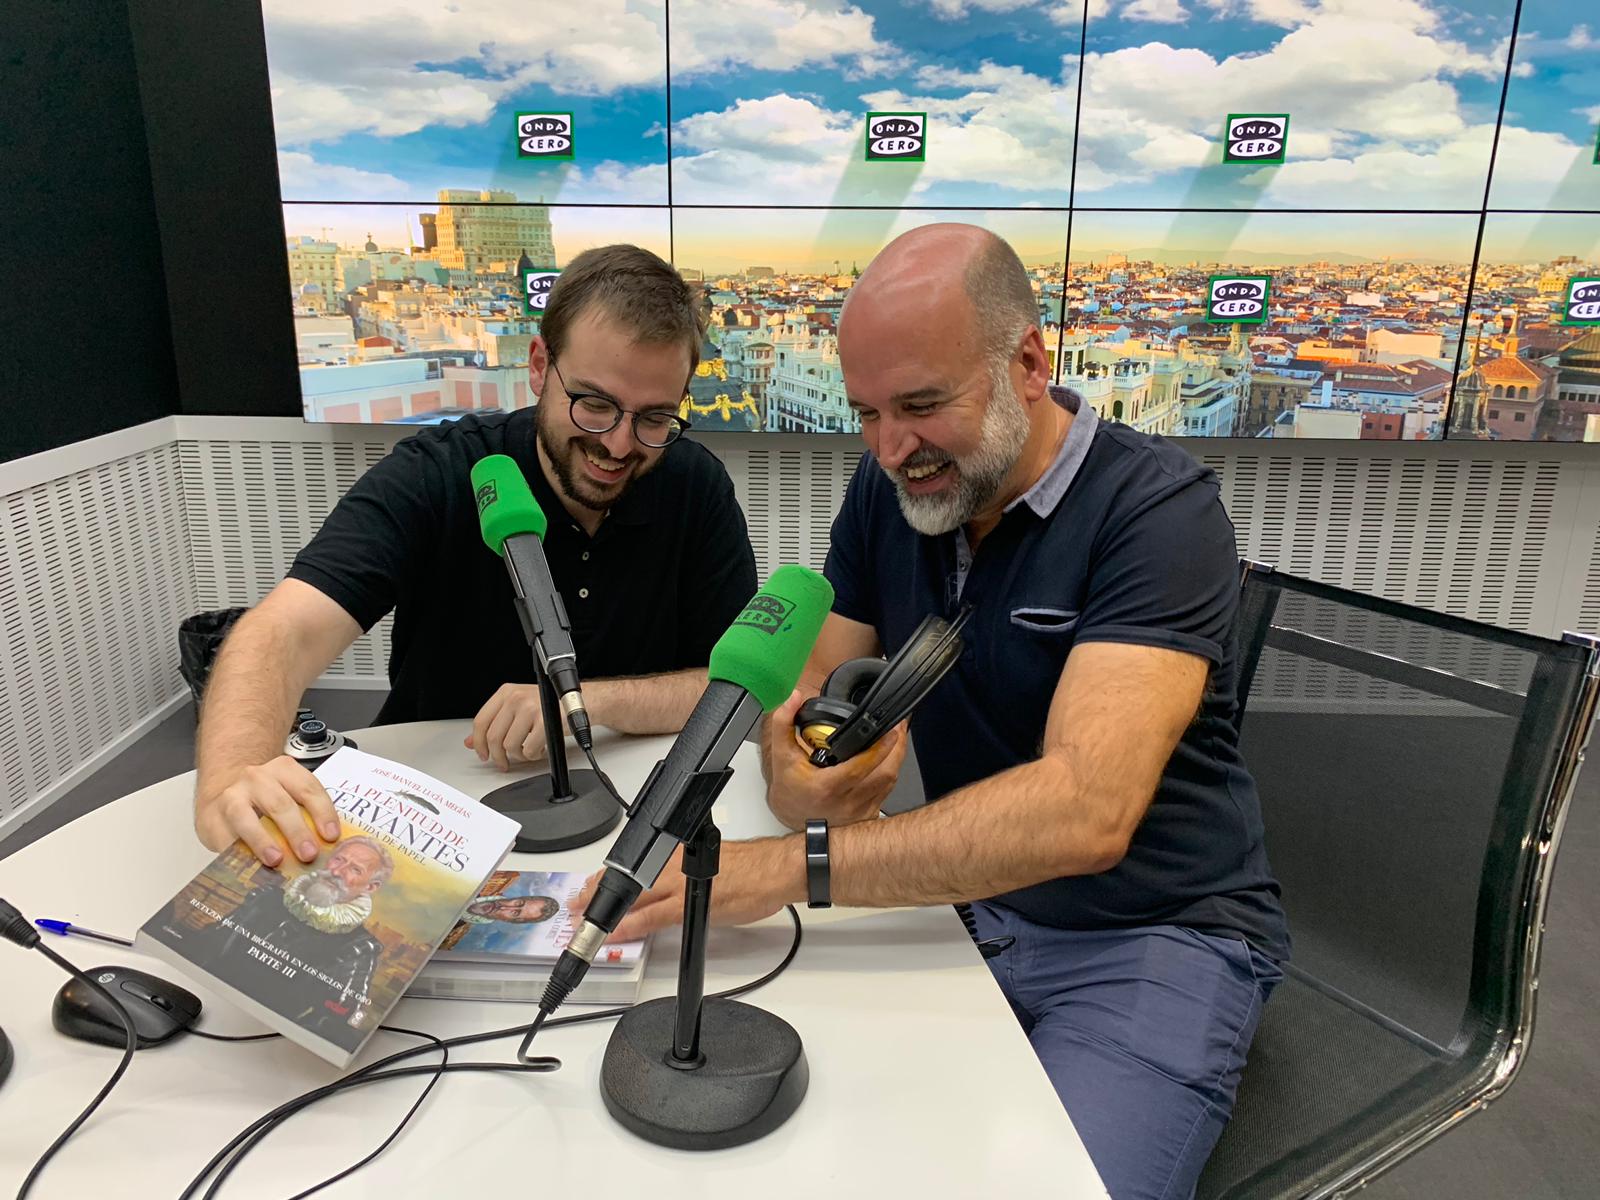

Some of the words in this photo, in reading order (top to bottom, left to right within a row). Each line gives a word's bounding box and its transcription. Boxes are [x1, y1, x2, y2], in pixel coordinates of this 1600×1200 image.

[525, 123, 564, 132] ONDA
[876, 124, 915, 134] ONDA
[1236, 126, 1276, 136] ONDA
[528, 139, 564, 149] CERO
[878, 140, 915, 150] CERO
[1237, 142, 1275, 153] CERO
[533, 280, 552, 289] ON
[1218, 287, 1257, 297] ONDA
[1577, 289, 1600, 298] ON
[1219, 303, 1256, 312] CERO
[751, 600, 780, 612] NDA
[391, 773, 421, 791] MANUEL
[339, 780, 360, 793] LA
[363, 787, 444, 834] PLENITUD
[443, 829, 468, 850] DE
[357, 820, 381, 839] VIDA
[382, 834, 397, 848] DE
[397, 843, 426, 867] PAPEL
[190, 897, 223, 921] RETAZOS
[222, 917, 236, 928] DE
[234, 924, 251, 938] UNA
[291, 957, 304, 967] EN
[302, 964, 319, 976] LOS
[317, 972, 344, 990] SIGLOS
[343, 987, 355, 997] DE
[355, 993, 372, 1006] ORO
[247, 946, 283, 971] PARTE
[281, 965, 297, 979] III
